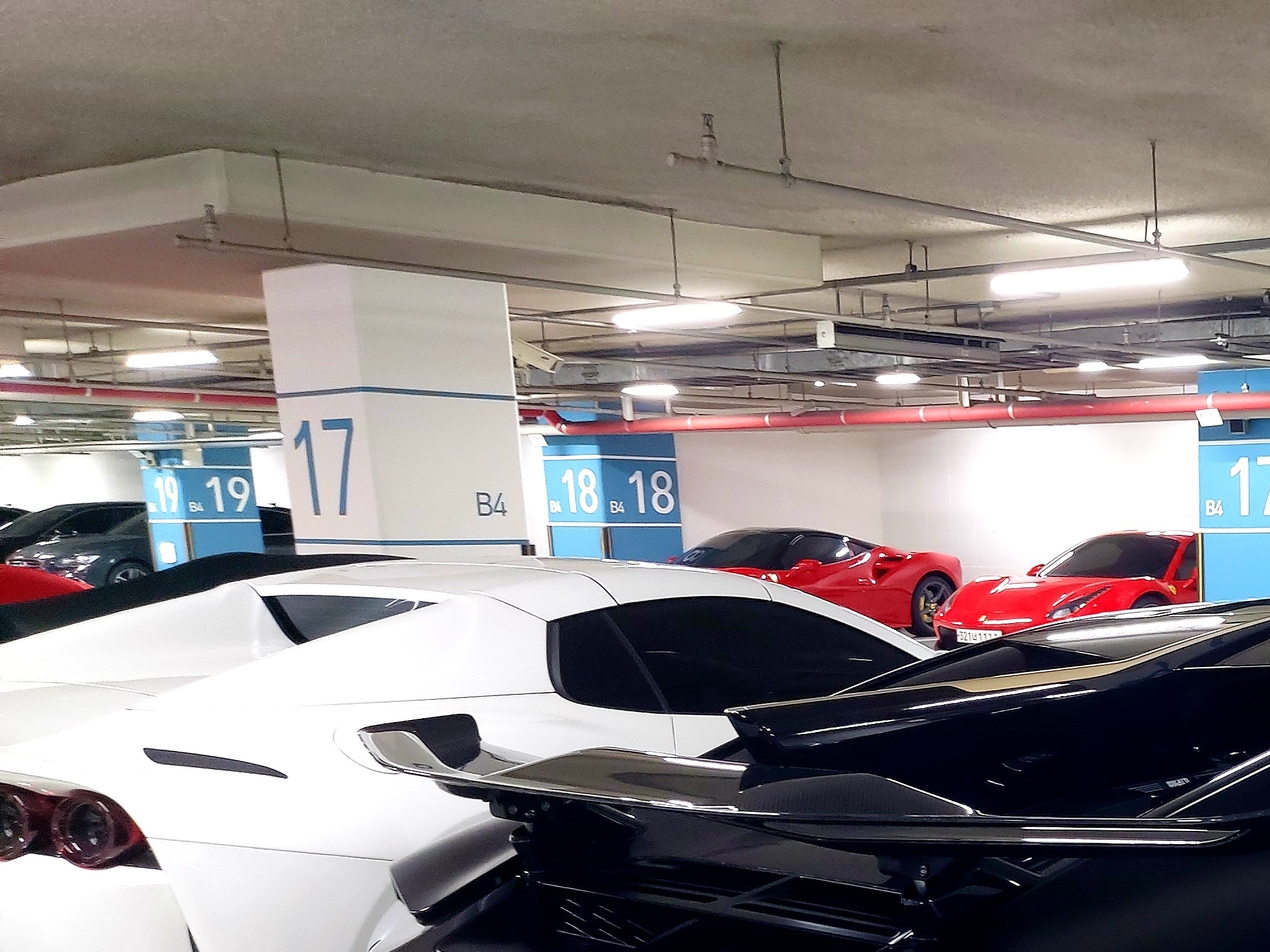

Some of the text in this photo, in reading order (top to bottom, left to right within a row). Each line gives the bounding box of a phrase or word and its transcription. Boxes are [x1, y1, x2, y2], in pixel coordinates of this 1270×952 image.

[294, 418, 353, 516] 17
[154, 476, 179, 512] 19
[188, 476, 250, 512] B4 19
[476, 491, 507, 516] B4
[561, 468, 599, 514] 18
[610, 470, 675, 514] B4 18
[1205, 499, 1224, 516] B4
